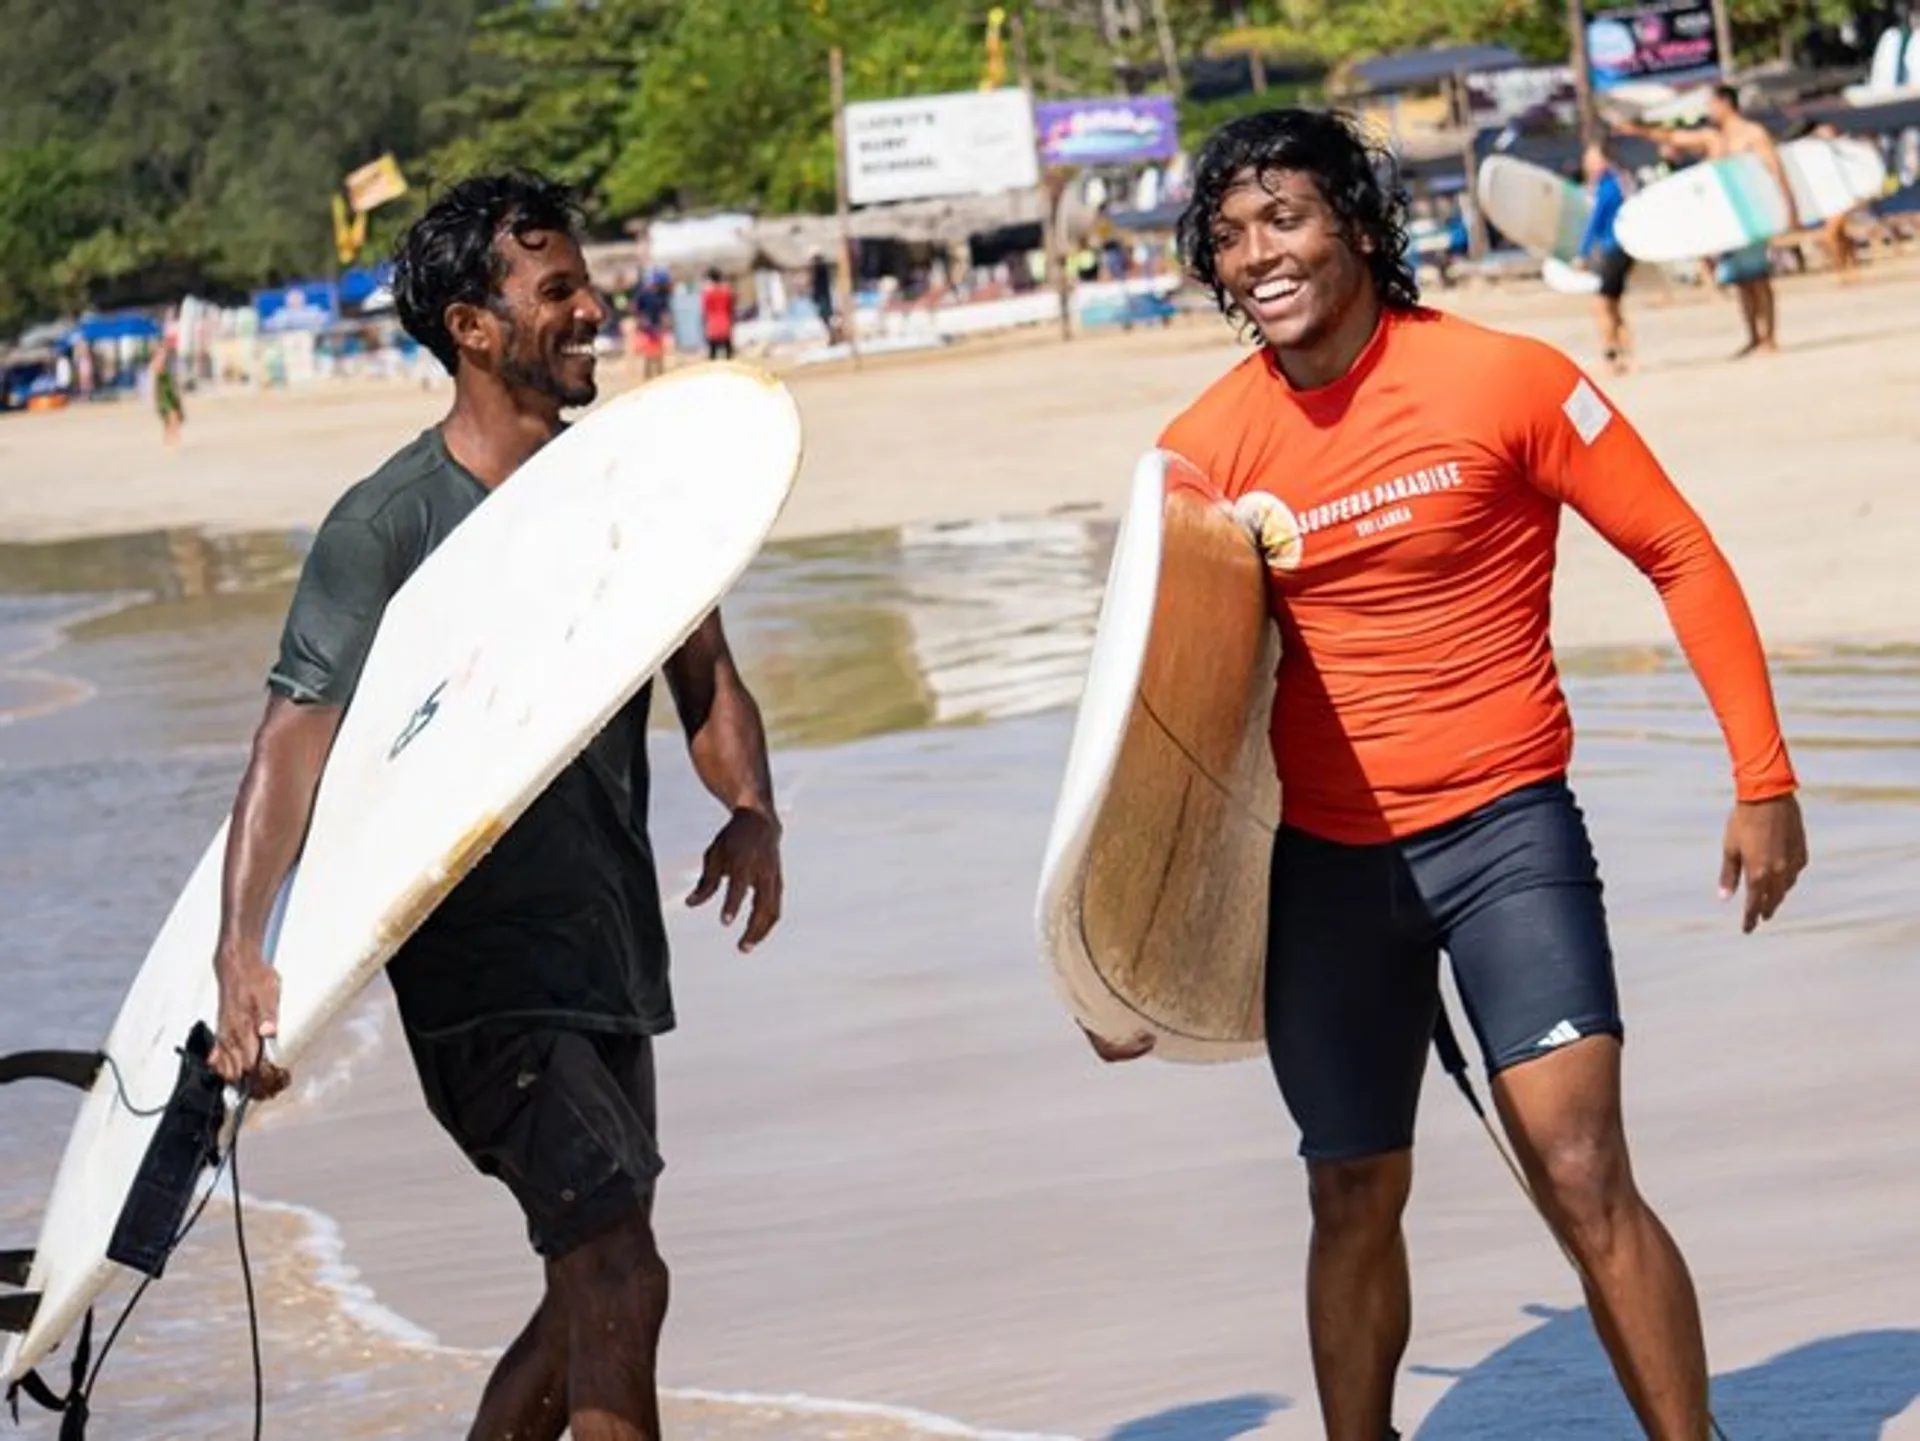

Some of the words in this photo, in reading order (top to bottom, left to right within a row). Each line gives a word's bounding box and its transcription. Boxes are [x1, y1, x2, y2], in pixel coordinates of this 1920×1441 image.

[1298, 490, 1372, 535] SURFERS
[1373, 461, 1462, 507] PARADISE
[1355, 519, 1376, 538] SRI
[1376, 505, 1412, 531] LANKA
